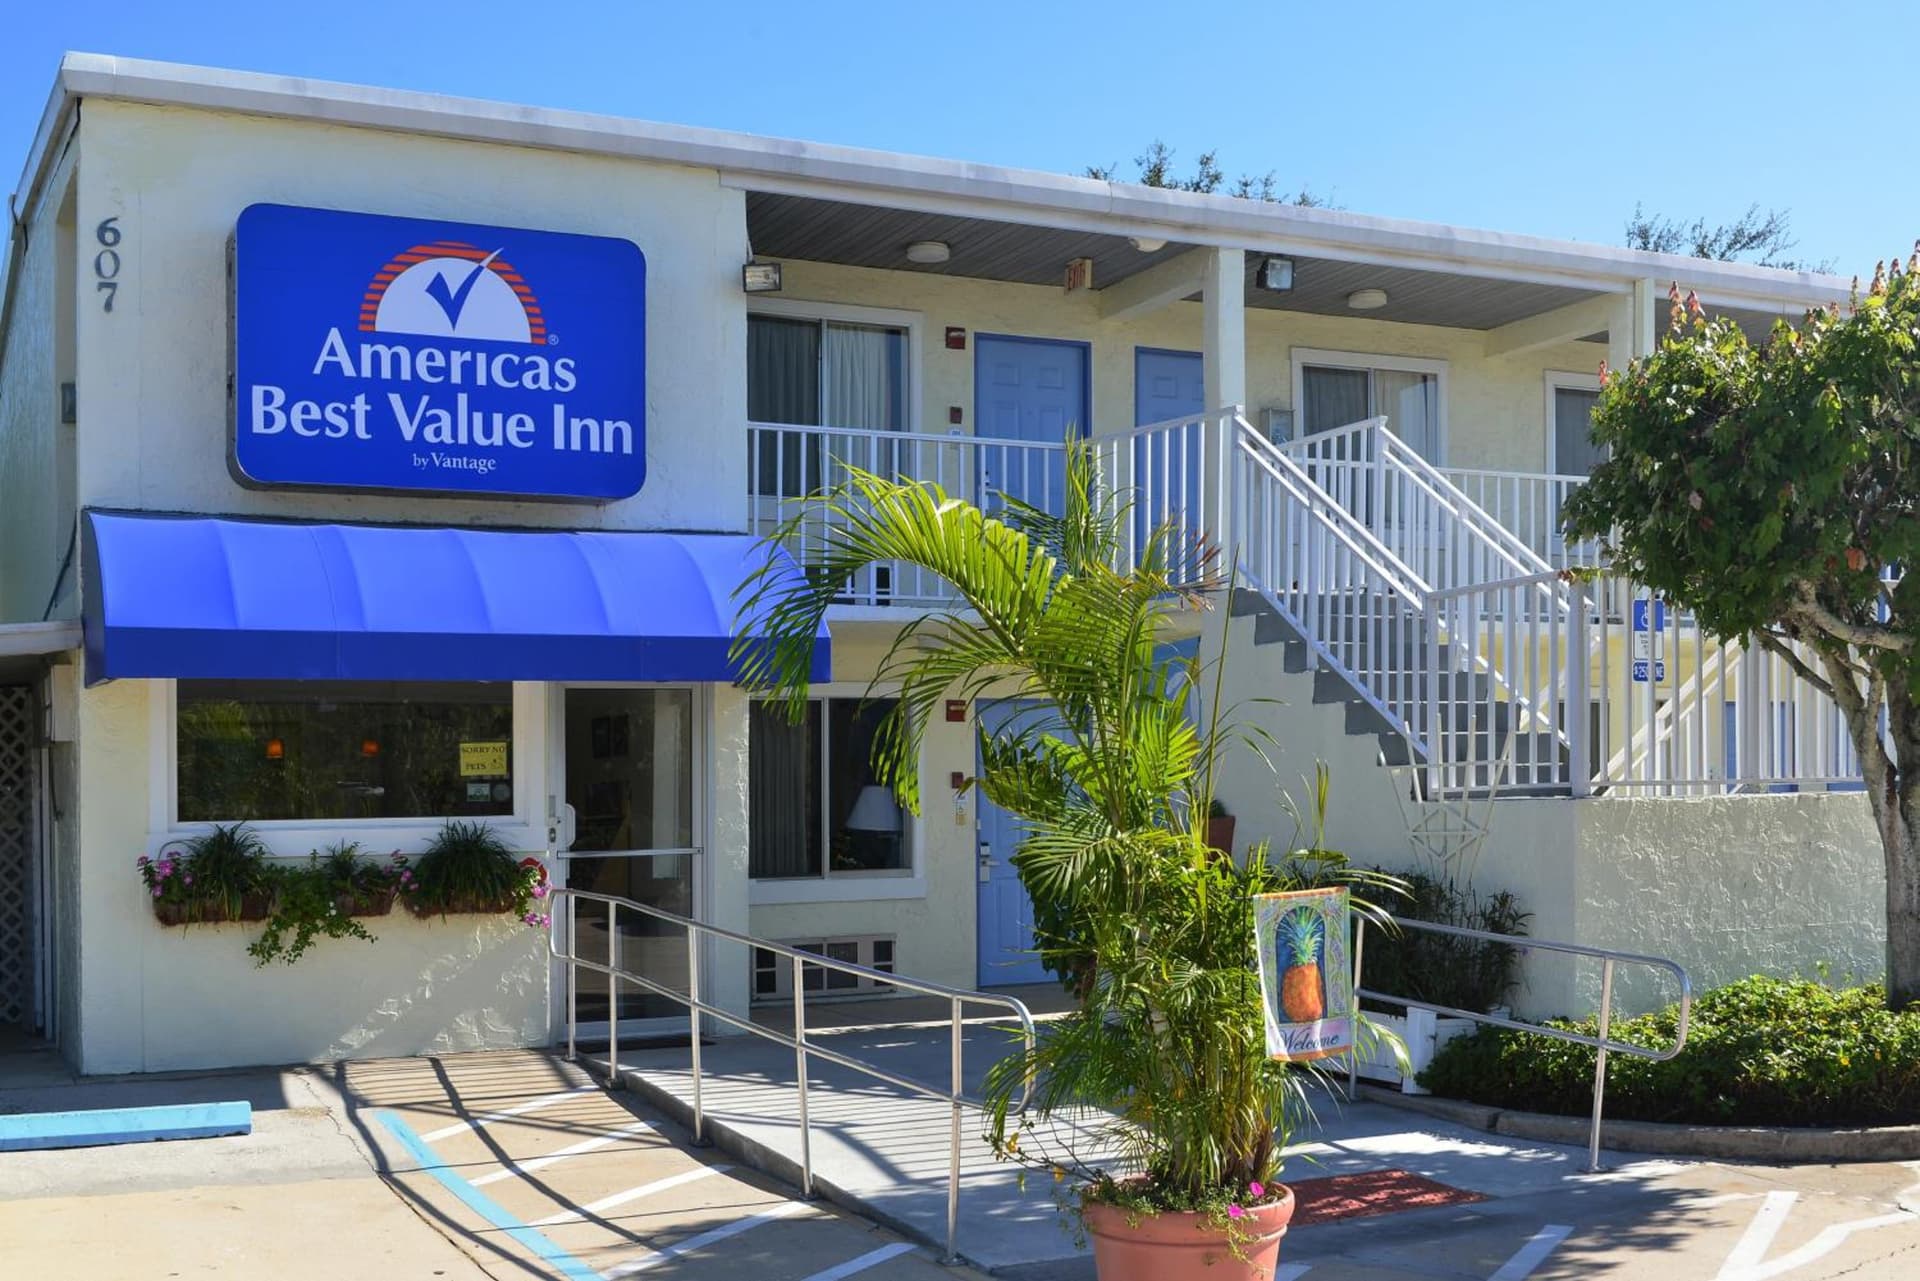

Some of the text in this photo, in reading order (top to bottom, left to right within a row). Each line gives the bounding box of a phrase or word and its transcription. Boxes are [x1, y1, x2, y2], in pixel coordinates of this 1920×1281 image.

[94, 216, 121, 313] 607
[312, 327, 577, 392] Americas
[251, 384, 633, 454] Best Value Inn
[412, 452, 497, 474] by Vantage
[1279, 1026, 1340, 1052] Welcome
